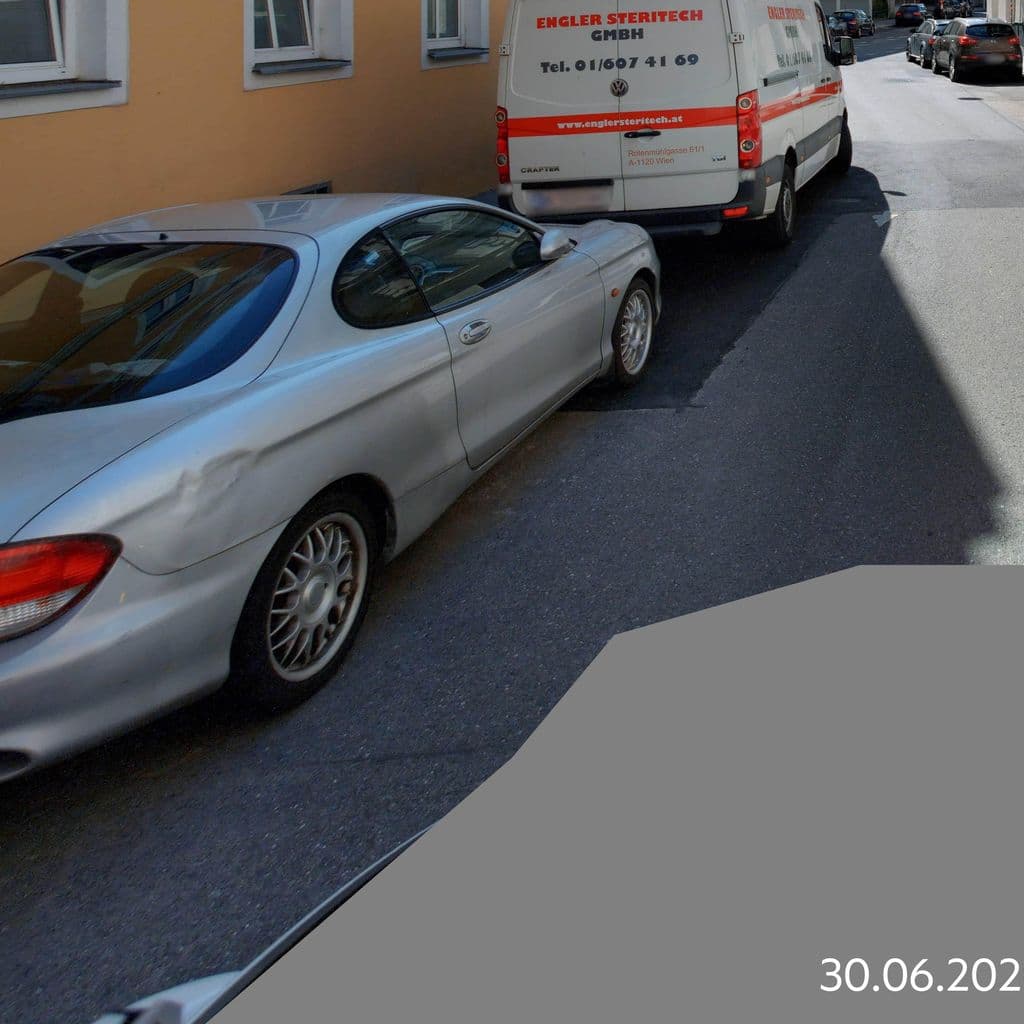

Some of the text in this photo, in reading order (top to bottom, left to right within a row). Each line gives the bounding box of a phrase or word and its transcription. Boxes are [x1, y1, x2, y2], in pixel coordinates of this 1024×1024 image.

[536, 10, 703, 29] ENGLER STERITECH
[591, 28, 644, 41] GMBH
[540, 53, 699, 73] Tel. 01/607 41 69
[557, 115, 684, 129] www.englersteritech.at
[656, 156, 675, 166] Wien
